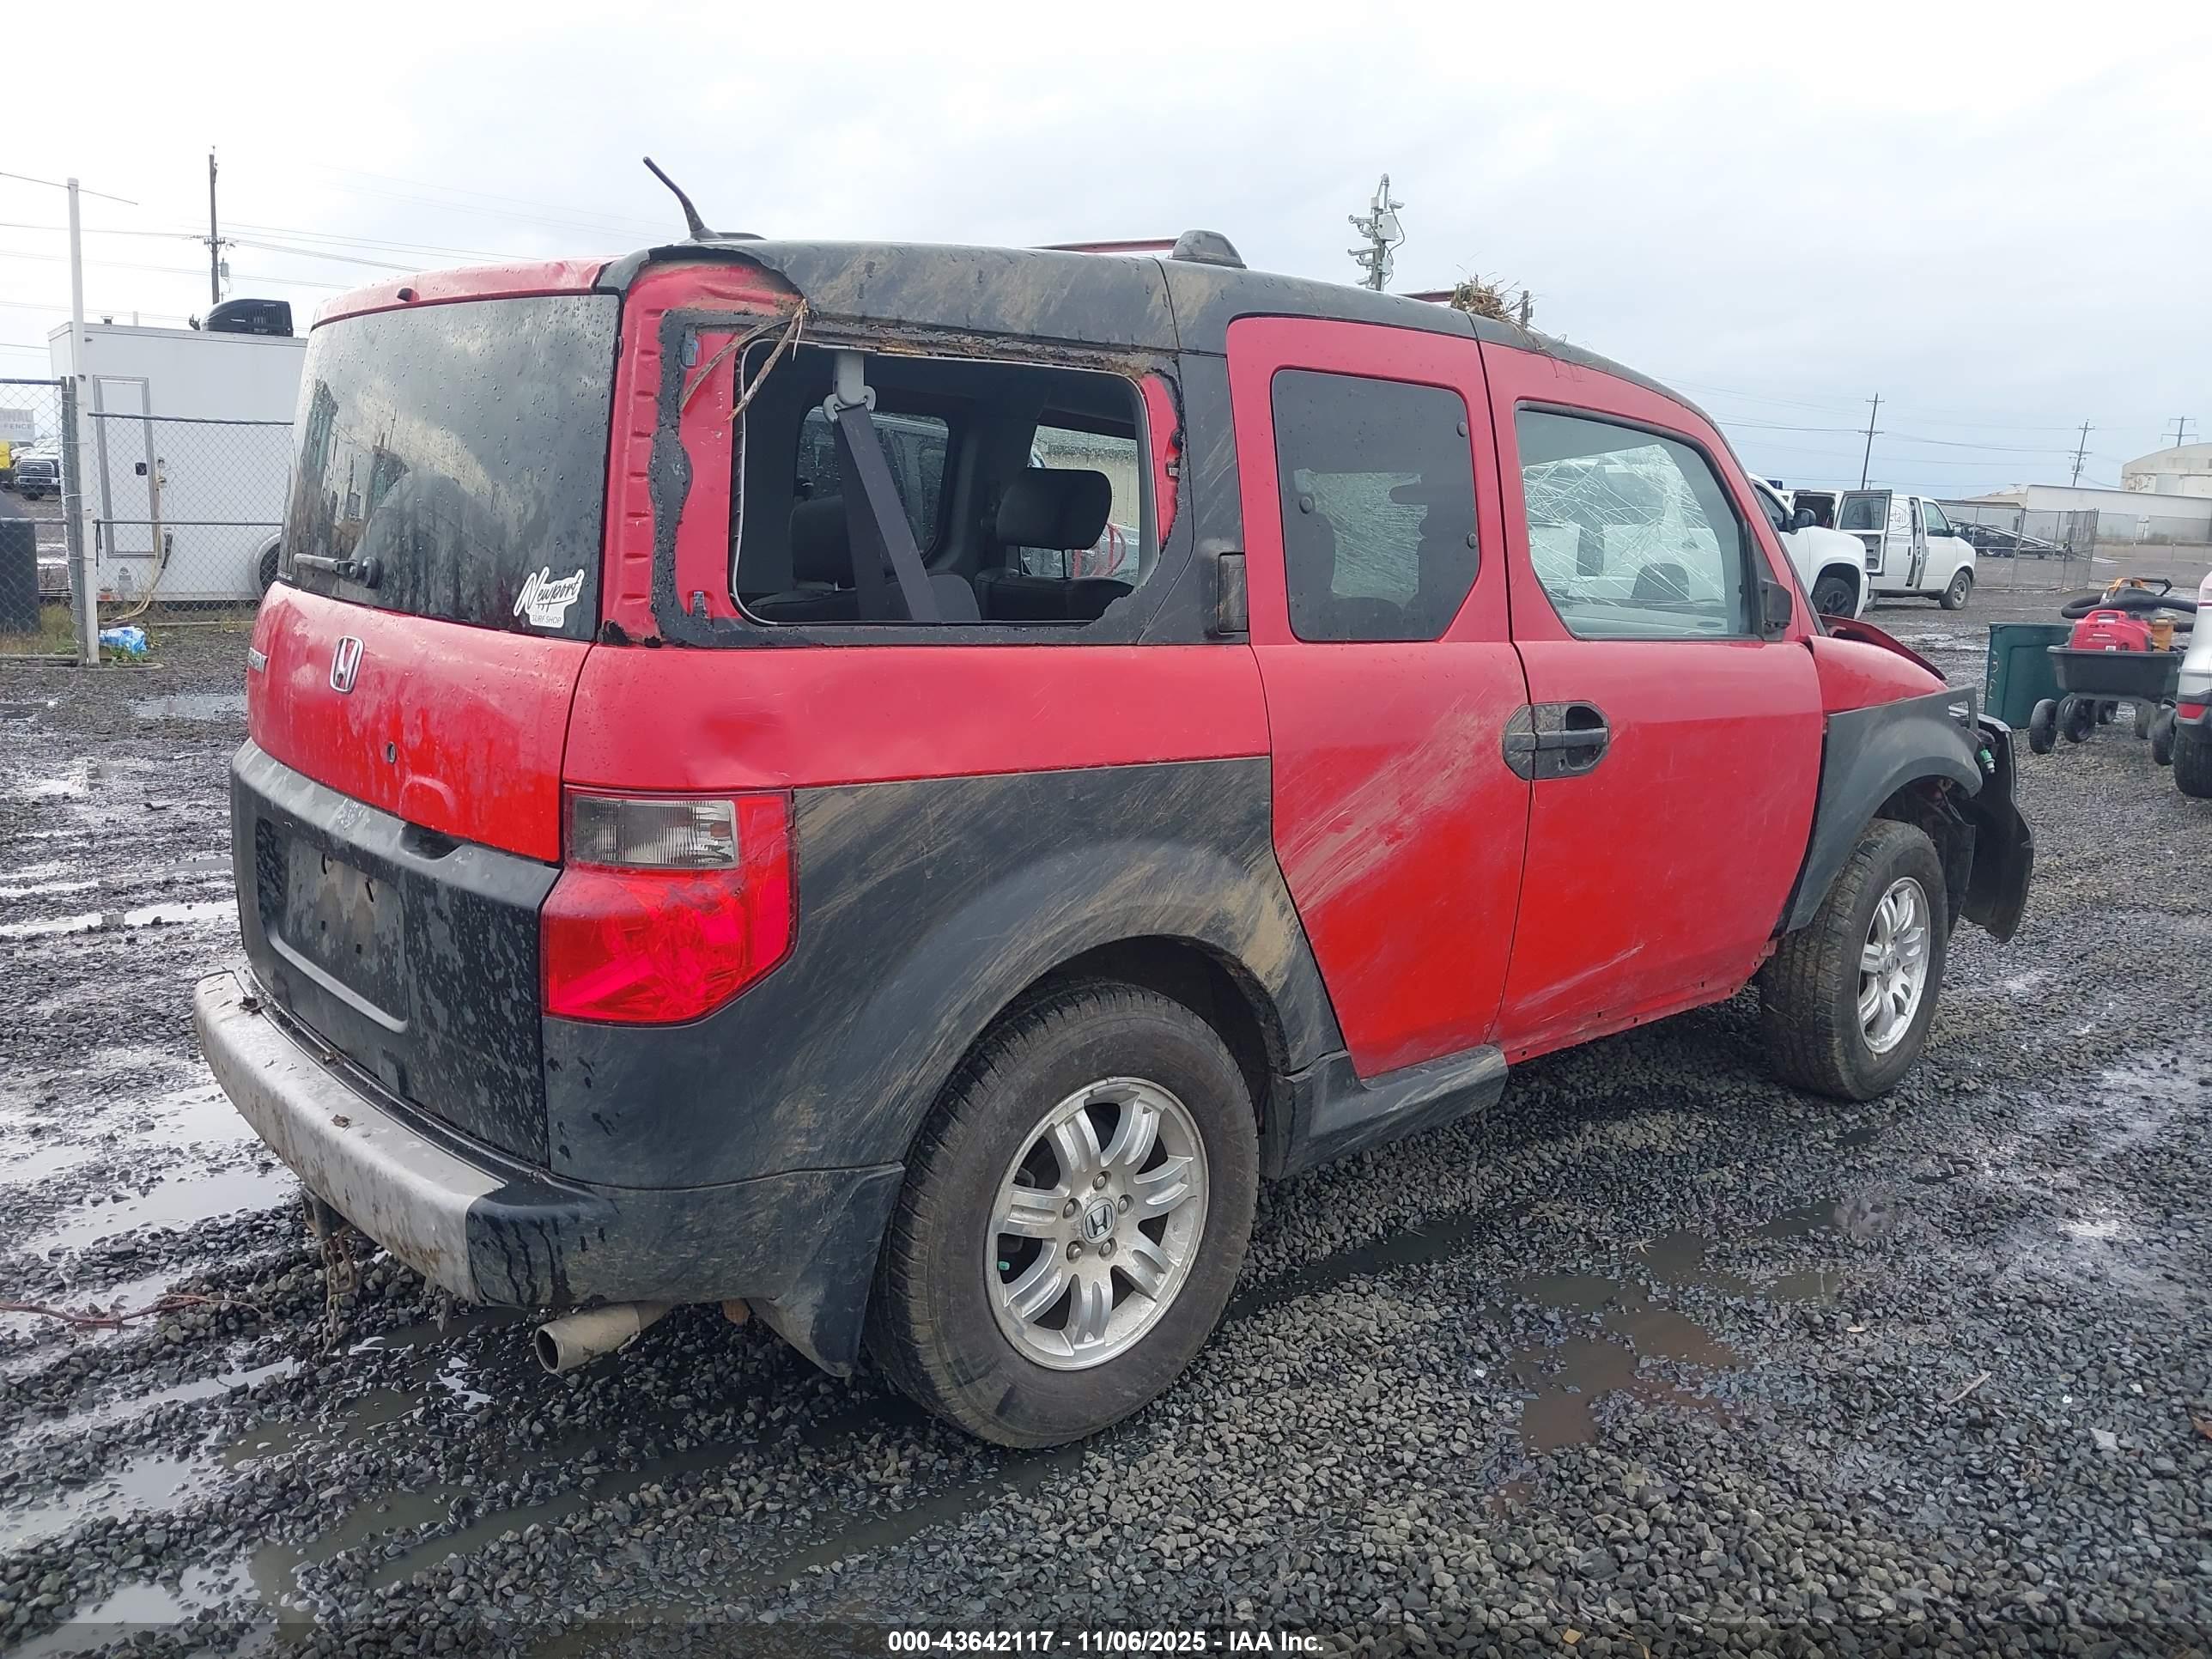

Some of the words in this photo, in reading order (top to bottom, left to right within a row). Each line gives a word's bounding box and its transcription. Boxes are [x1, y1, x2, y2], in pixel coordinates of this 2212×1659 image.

[515, 569, 582, 612] Newport
[532, 613, 545, 623] SURF
[545, 615, 562, 624] SHOP
